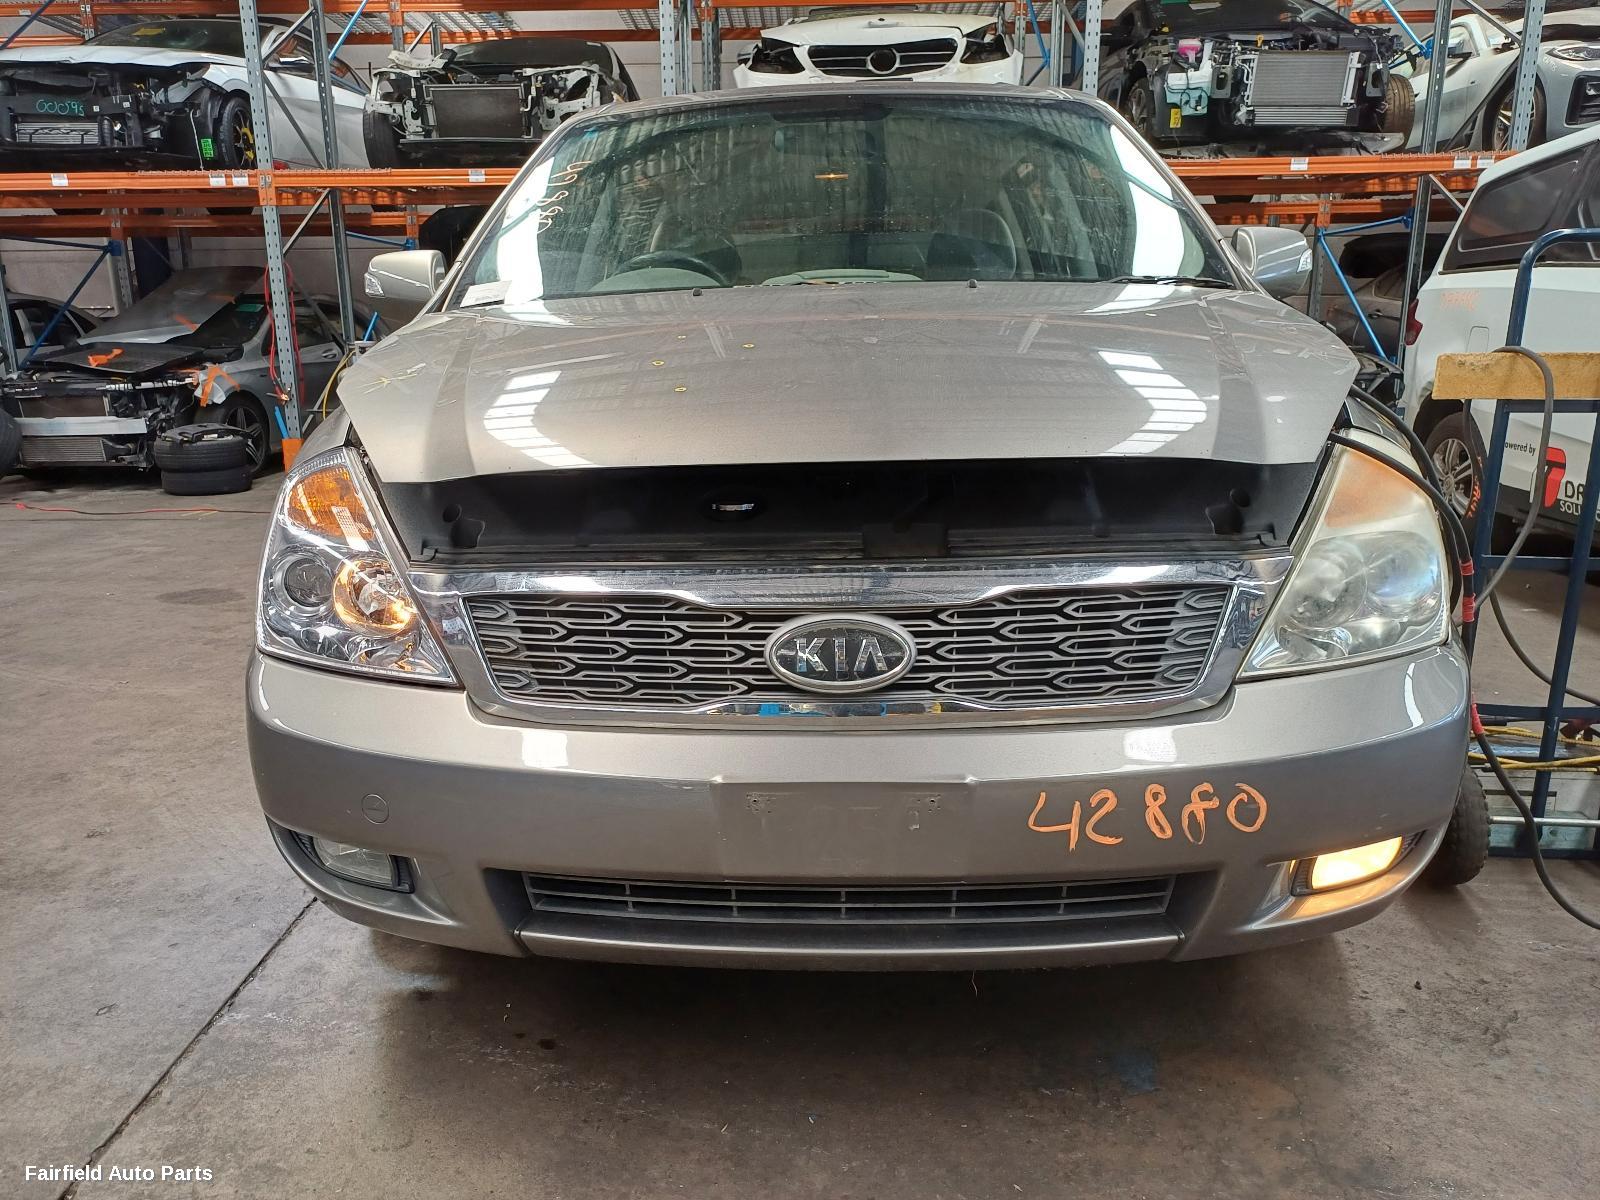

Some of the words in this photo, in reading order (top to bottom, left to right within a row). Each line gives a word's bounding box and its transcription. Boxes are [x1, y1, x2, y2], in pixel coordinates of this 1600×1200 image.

[1504, 441, 1528, 453] owered
[1528, 443, 1537, 457] by
[1564, 479, 1585, 502] DR
[794, 636, 889, 673] KIA
